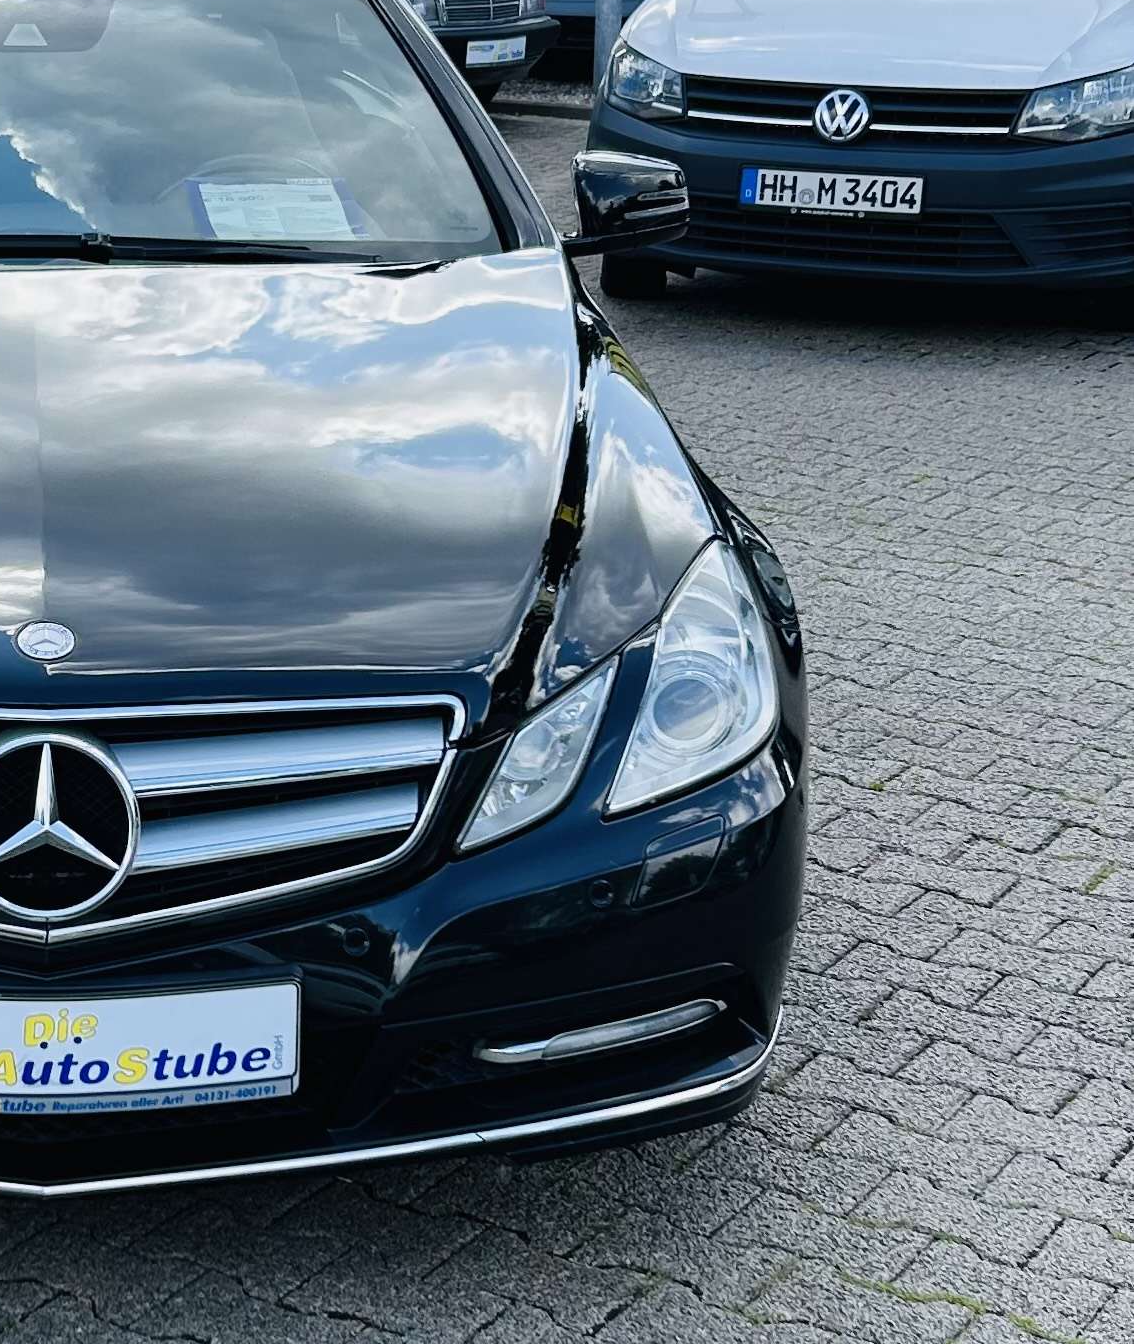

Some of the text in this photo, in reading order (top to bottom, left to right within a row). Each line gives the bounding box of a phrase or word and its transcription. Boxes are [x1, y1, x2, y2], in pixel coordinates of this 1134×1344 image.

[758, 173, 798, 203] HH
[842, 178, 917, 209] 3404
[23, 1008, 98, 1047] Die
[272, 1033, 283, 1070] GmbH
[52, 1100, 128, 1112] Reparaturen
[131, 1097, 159, 1108] aller
[194, 1085, 277, 1103] 04131-400191
